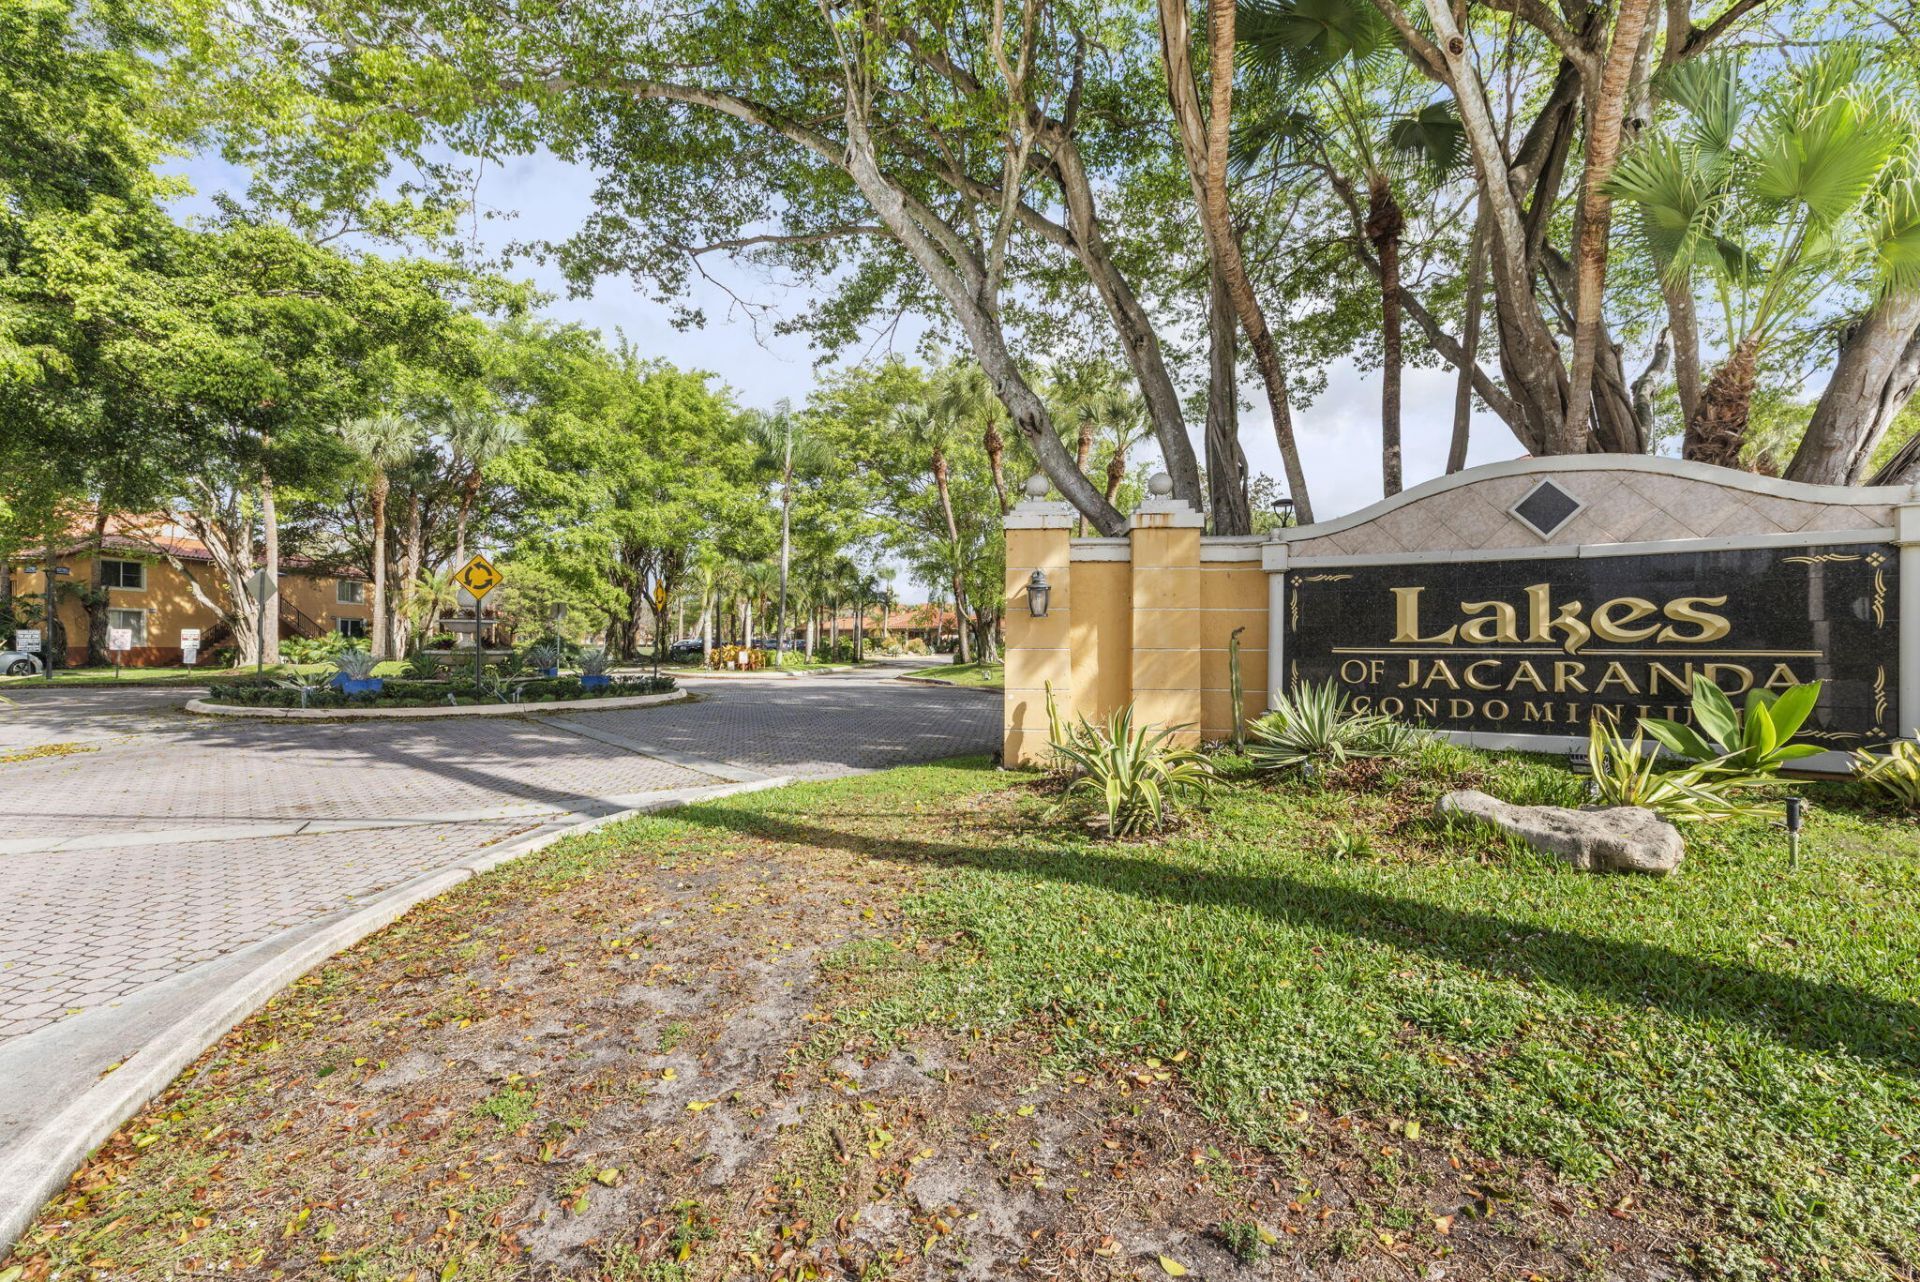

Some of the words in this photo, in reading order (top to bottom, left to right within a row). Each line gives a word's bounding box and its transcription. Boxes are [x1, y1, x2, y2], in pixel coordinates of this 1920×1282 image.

[1389, 582, 1732, 656] Lakes
[1340, 659, 1385, 685] OF
[1397, 659, 1802, 697] JACARANDA
[1351, 695, 1745, 730] CONDOMINIU
